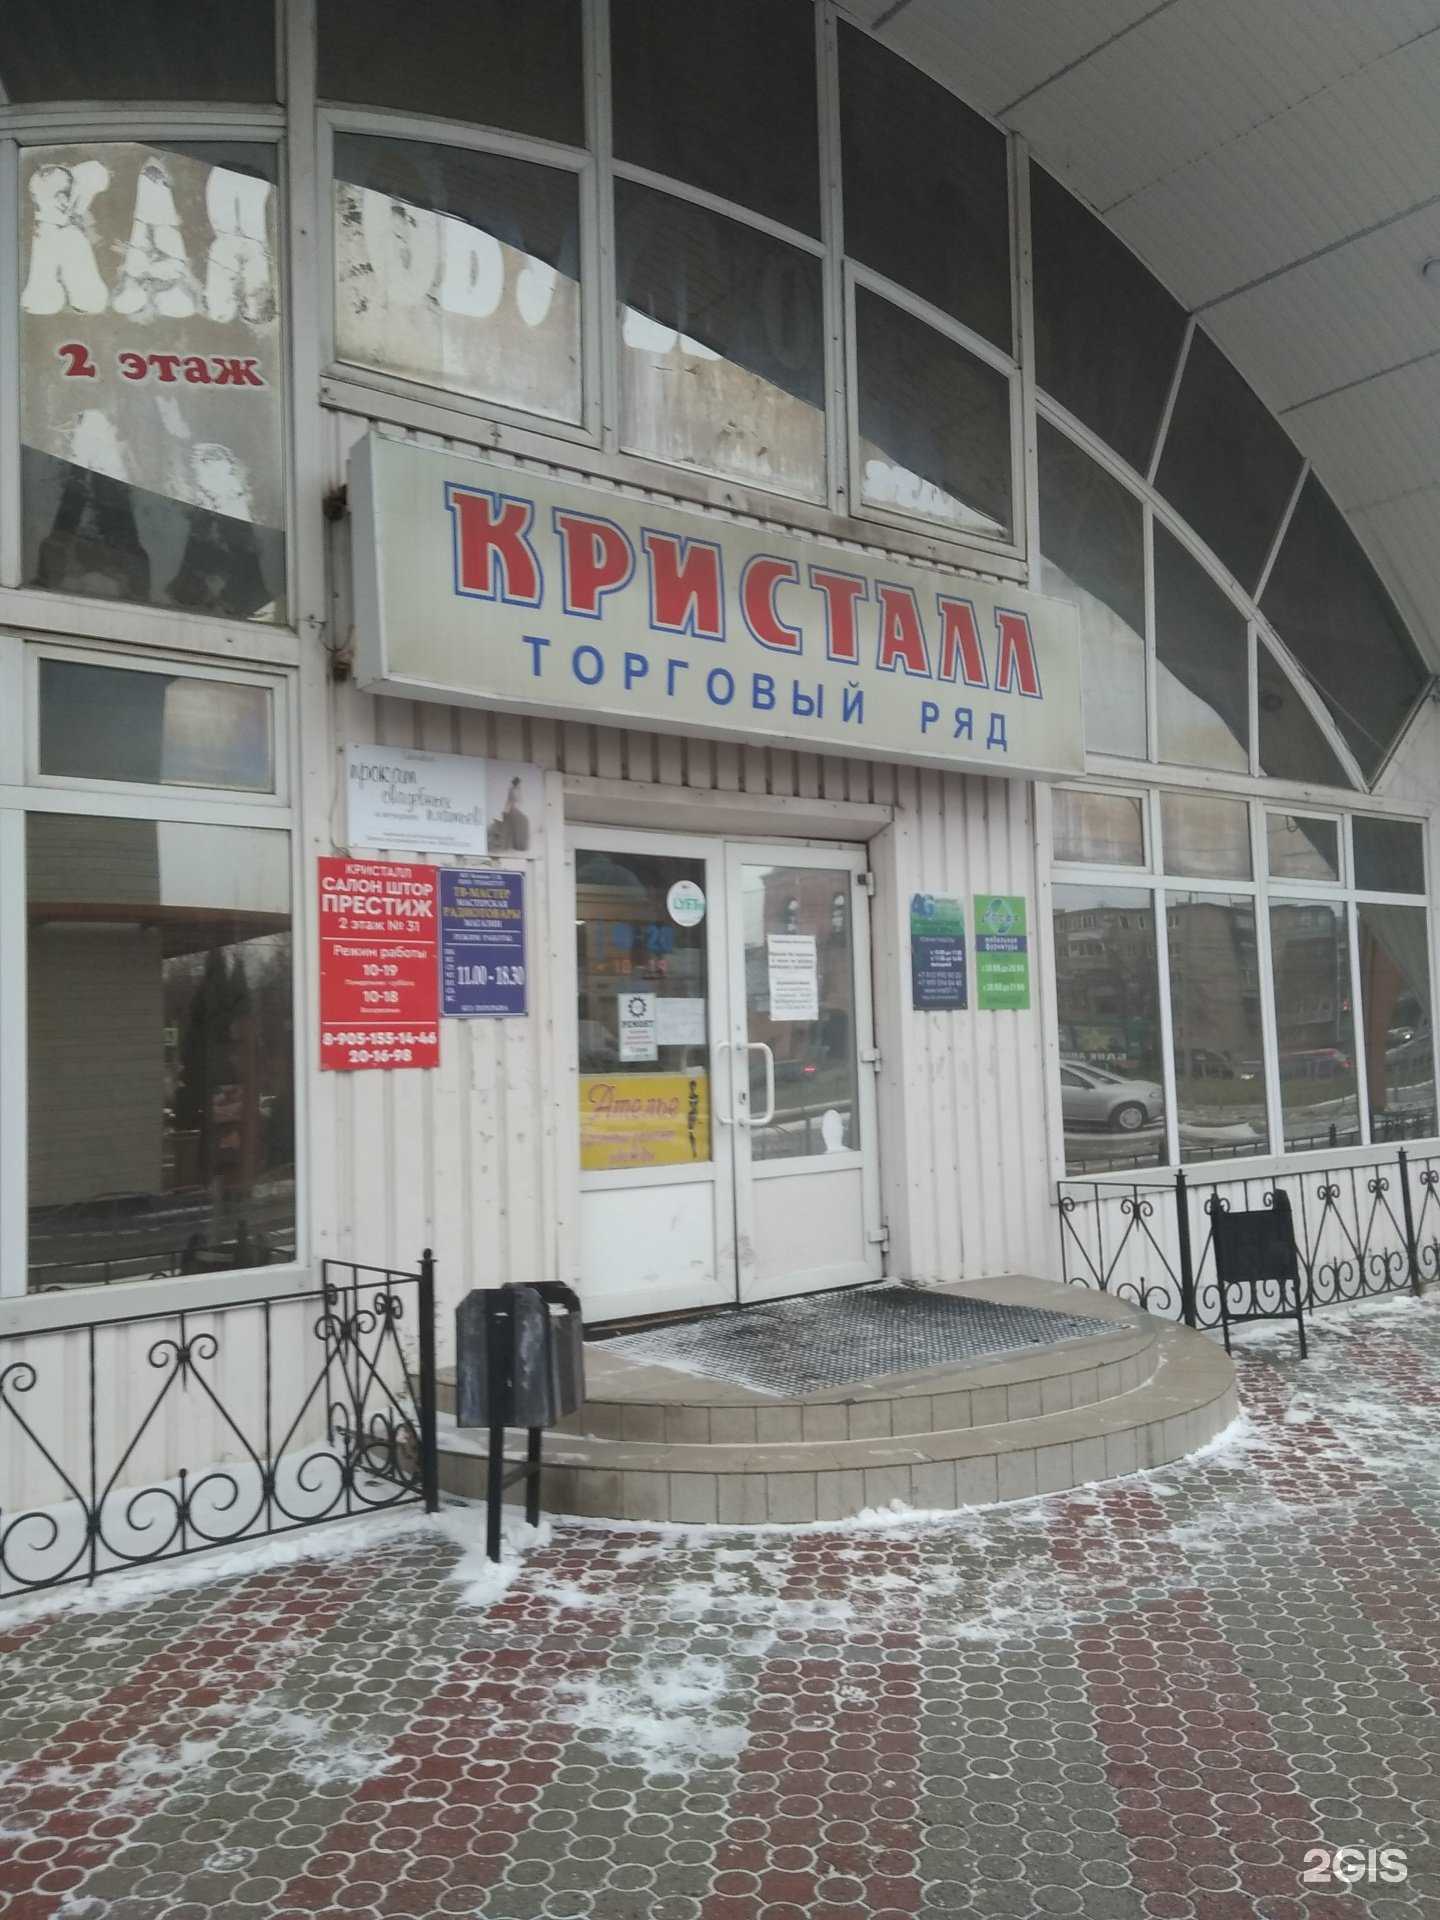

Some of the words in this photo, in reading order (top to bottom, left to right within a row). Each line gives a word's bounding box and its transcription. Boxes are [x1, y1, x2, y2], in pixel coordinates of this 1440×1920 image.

[56, 342, 97, 380] 2
[117, 351, 266, 388] этаж
[443, 480, 1043, 699] КРИСТАЛЛ
[522, 635, 865, 726] ТОРГОВЫЙ
[919, 701, 1008, 753] РЯД
[344, 863, 413, 879] КРИСТАЛЛ
[321, 876, 384, 894] САЛОН
[385, 880, 434, 897] ШТОР
[321, 893, 435, 918] ПРЕСТИЖ
[338, 917, 349, 930] 2
[351, 919, 385, 932] этаж
[332, 943, 378, 958] Режим
